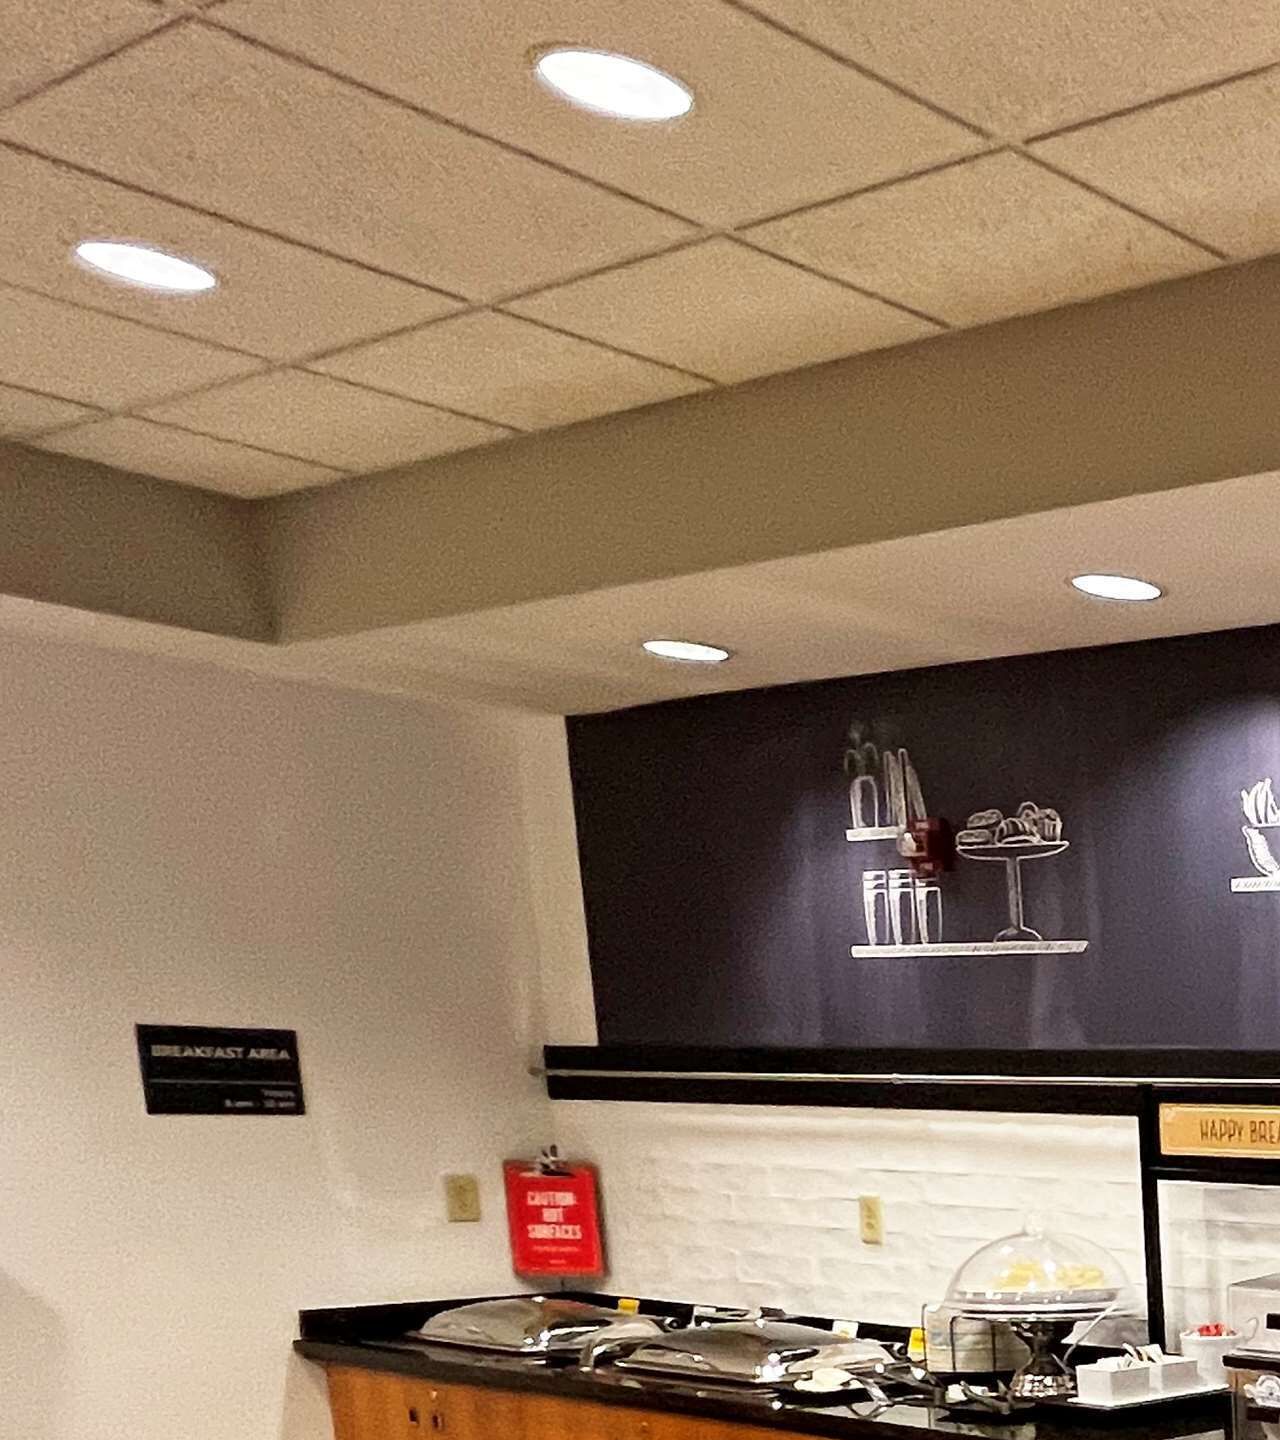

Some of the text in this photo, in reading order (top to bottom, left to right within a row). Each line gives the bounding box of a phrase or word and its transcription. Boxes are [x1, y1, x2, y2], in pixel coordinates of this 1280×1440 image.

[151, 1044, 291, 1061] BREAKFAST AREA
[1200, 1117, 1243, 1142] HAPPY
[542, 1207, 565, 1222] HOT
[527, 1224, 583, 1239] SURFACES
